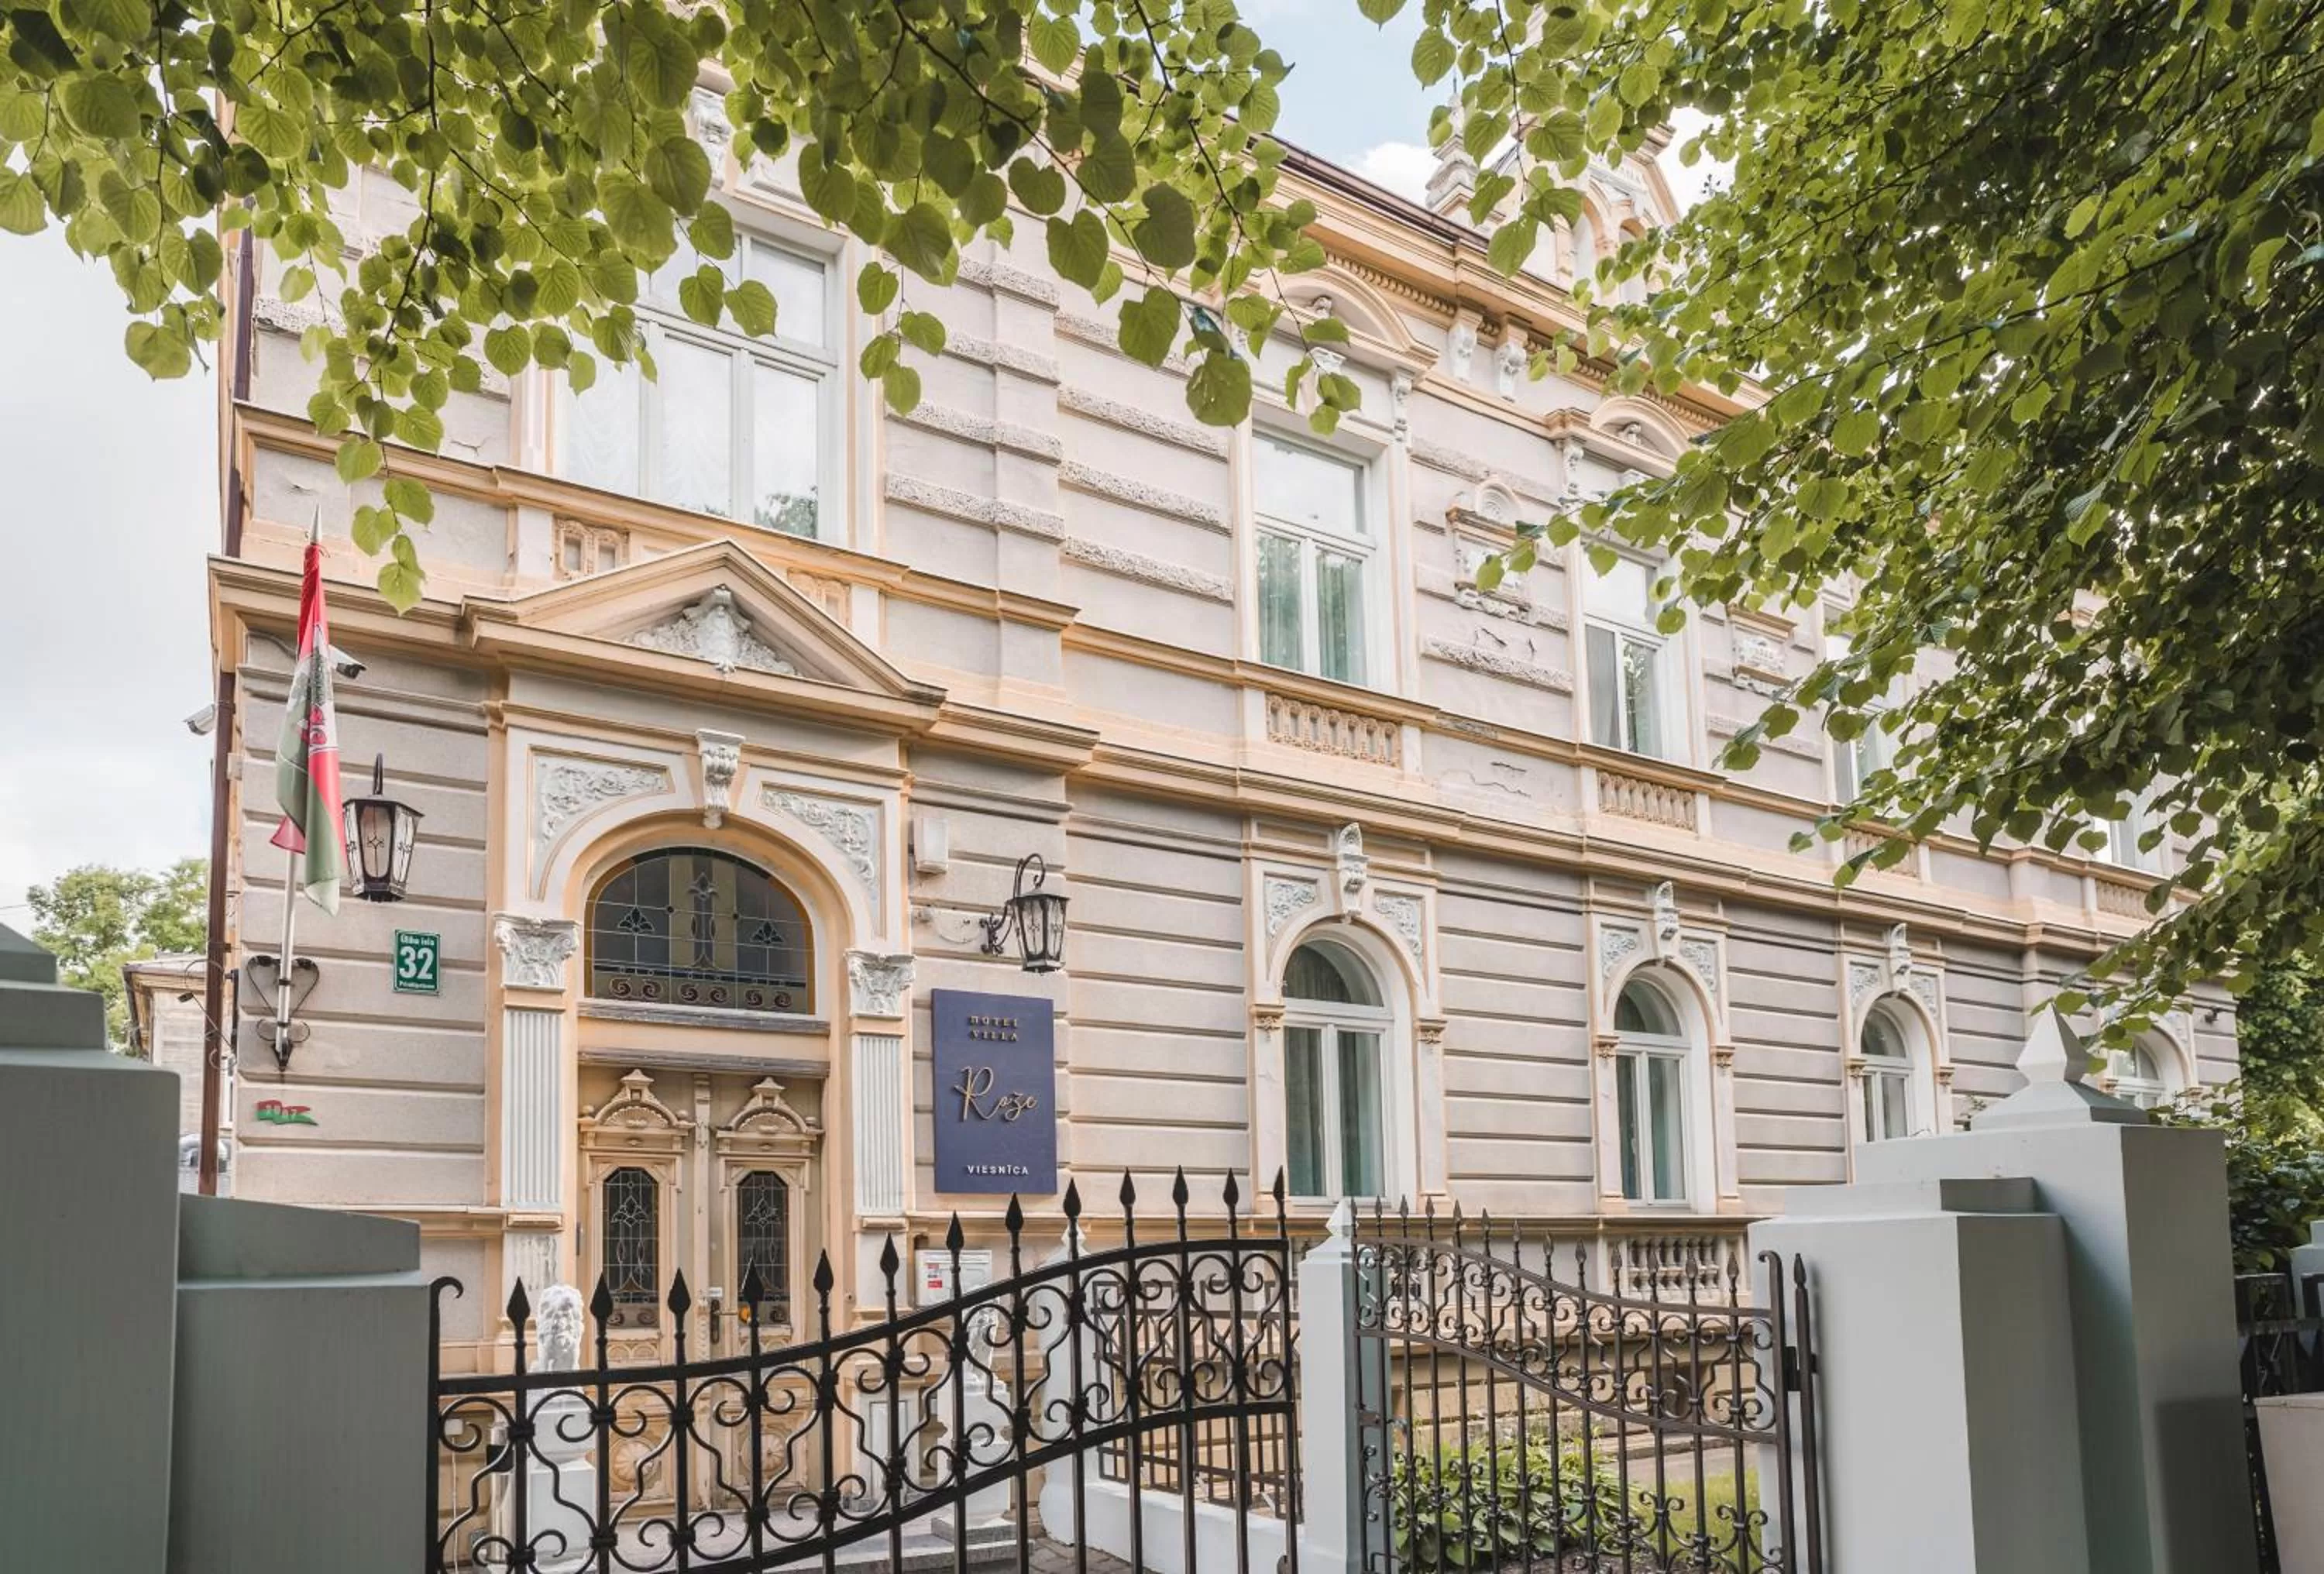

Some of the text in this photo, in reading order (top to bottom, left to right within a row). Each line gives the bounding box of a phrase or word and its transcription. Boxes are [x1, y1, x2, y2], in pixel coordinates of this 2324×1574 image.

[400, 946, 434, 979] 32
[971, 1029, 1018, 1041] VILLA
[968, 1163, 1030, 1175] VIESNĪCA
